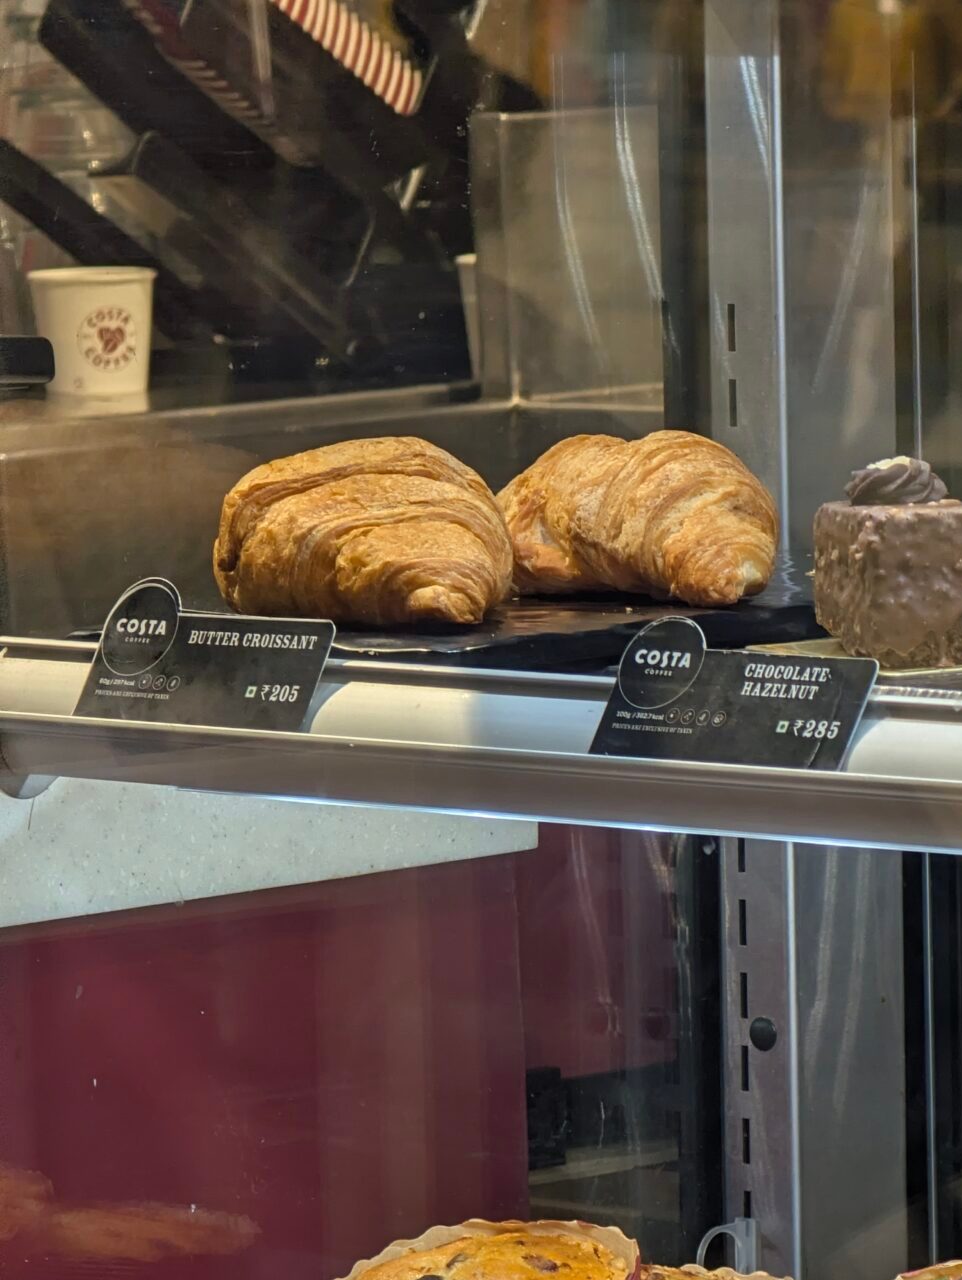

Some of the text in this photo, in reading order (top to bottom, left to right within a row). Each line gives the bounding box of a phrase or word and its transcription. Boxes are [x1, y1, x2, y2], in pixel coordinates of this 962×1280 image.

[86, 307, 131, 328] COSTA
[116, 618, 167, 636] COSTA
[125, 637, 150, 645] COFFEE
[188, 630, 318, 650] BUTTER CROISSANT
[635, 649, 691, 669] COSTA
[645, 669, 672, 677] COFFEE
[744, 664, 828, 682] CHOCOLATE
[261, 684, 299, 703] ₹205
[741, 682, 818, 700] HAZELNUT
[793, 720, 840, 739] ₹285
